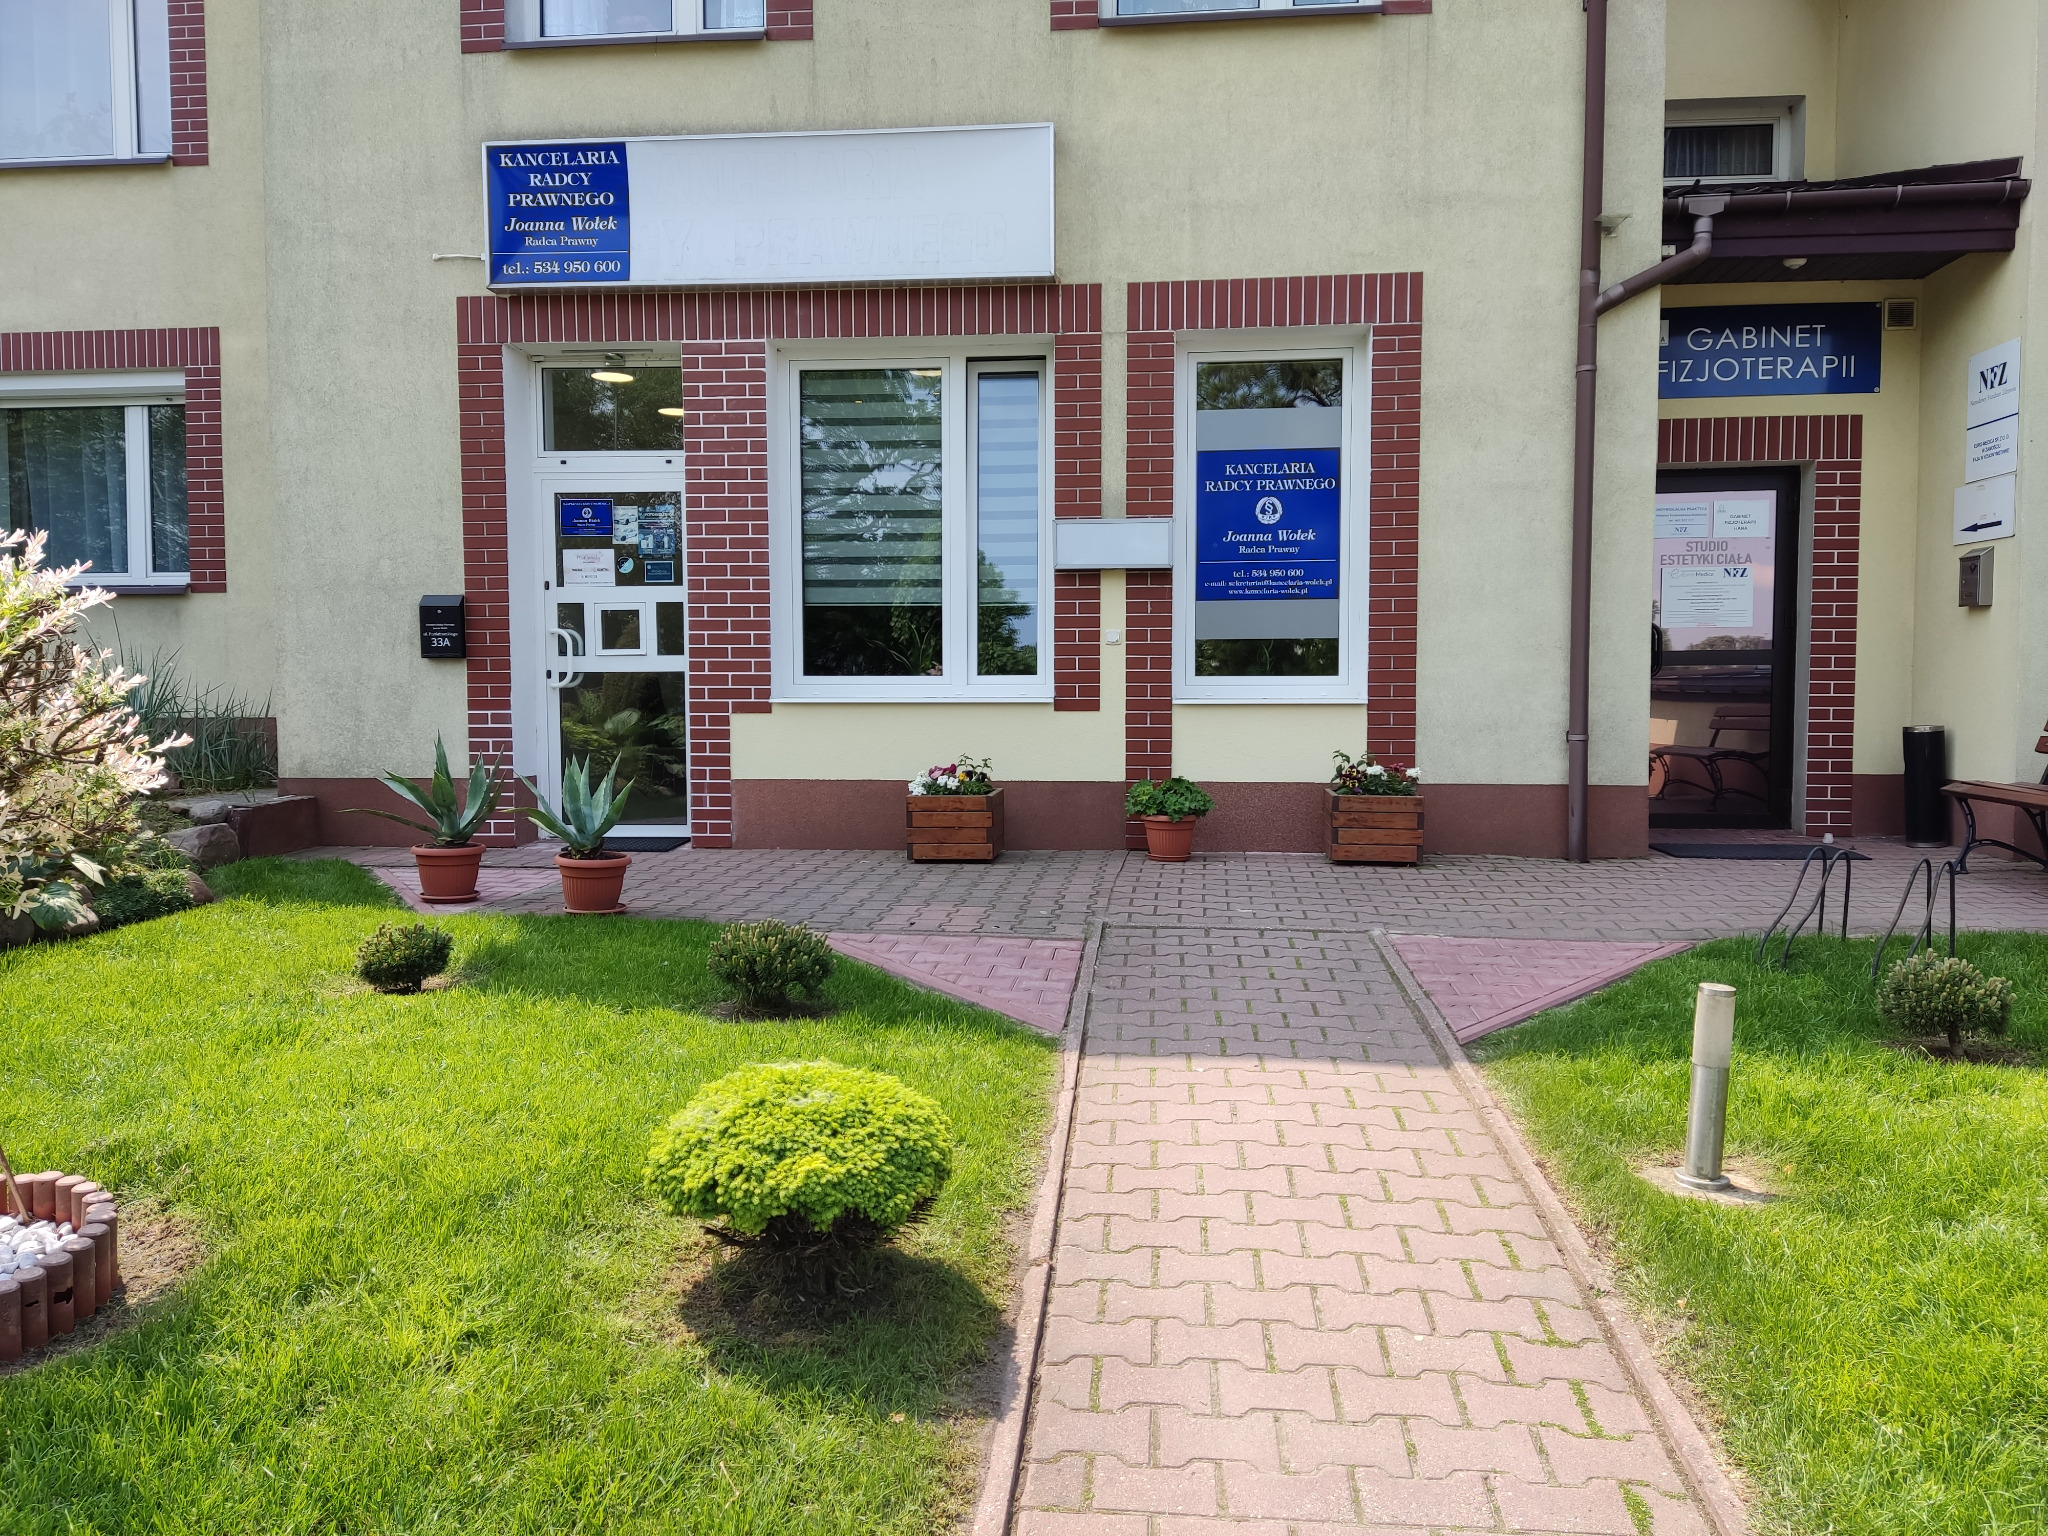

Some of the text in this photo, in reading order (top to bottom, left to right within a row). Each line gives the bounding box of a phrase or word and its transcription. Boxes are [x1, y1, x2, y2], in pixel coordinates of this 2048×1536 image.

[499, 150, 621, 167] KANCELARIA
[528, 172, 593, 187] RADCY
[507, 192, 615, 207] PRAWNEGO
[504, 215, 618, 232] Joanna Wołek
[524, 235, 598, 248] Radca Prawny
[502, 260, 621, 275] tel.: 534 950 600
[1686, 324, 1826, 351] GABINET
[1979, 361, 2008, 394] NFZ
[1225, 462, 1316, 476] KANCELARIA
[1205, 478, 1336, 492] RADCY PRAWNEGO
[1222, 528, 1317, 542] Joanna Wołek
[1238, 545, 1300, 555] Radca Prawny
[1686, 540, 1728, 553] STUDIO
[1660, 552, 1753, 566] ESTETYKI CIAŁA
[1233, 568, 1304, 578] tel.: 534 950 600
[1723, 567, 1749, 578] NFZ
[430, 637, 451, 647] 33A
